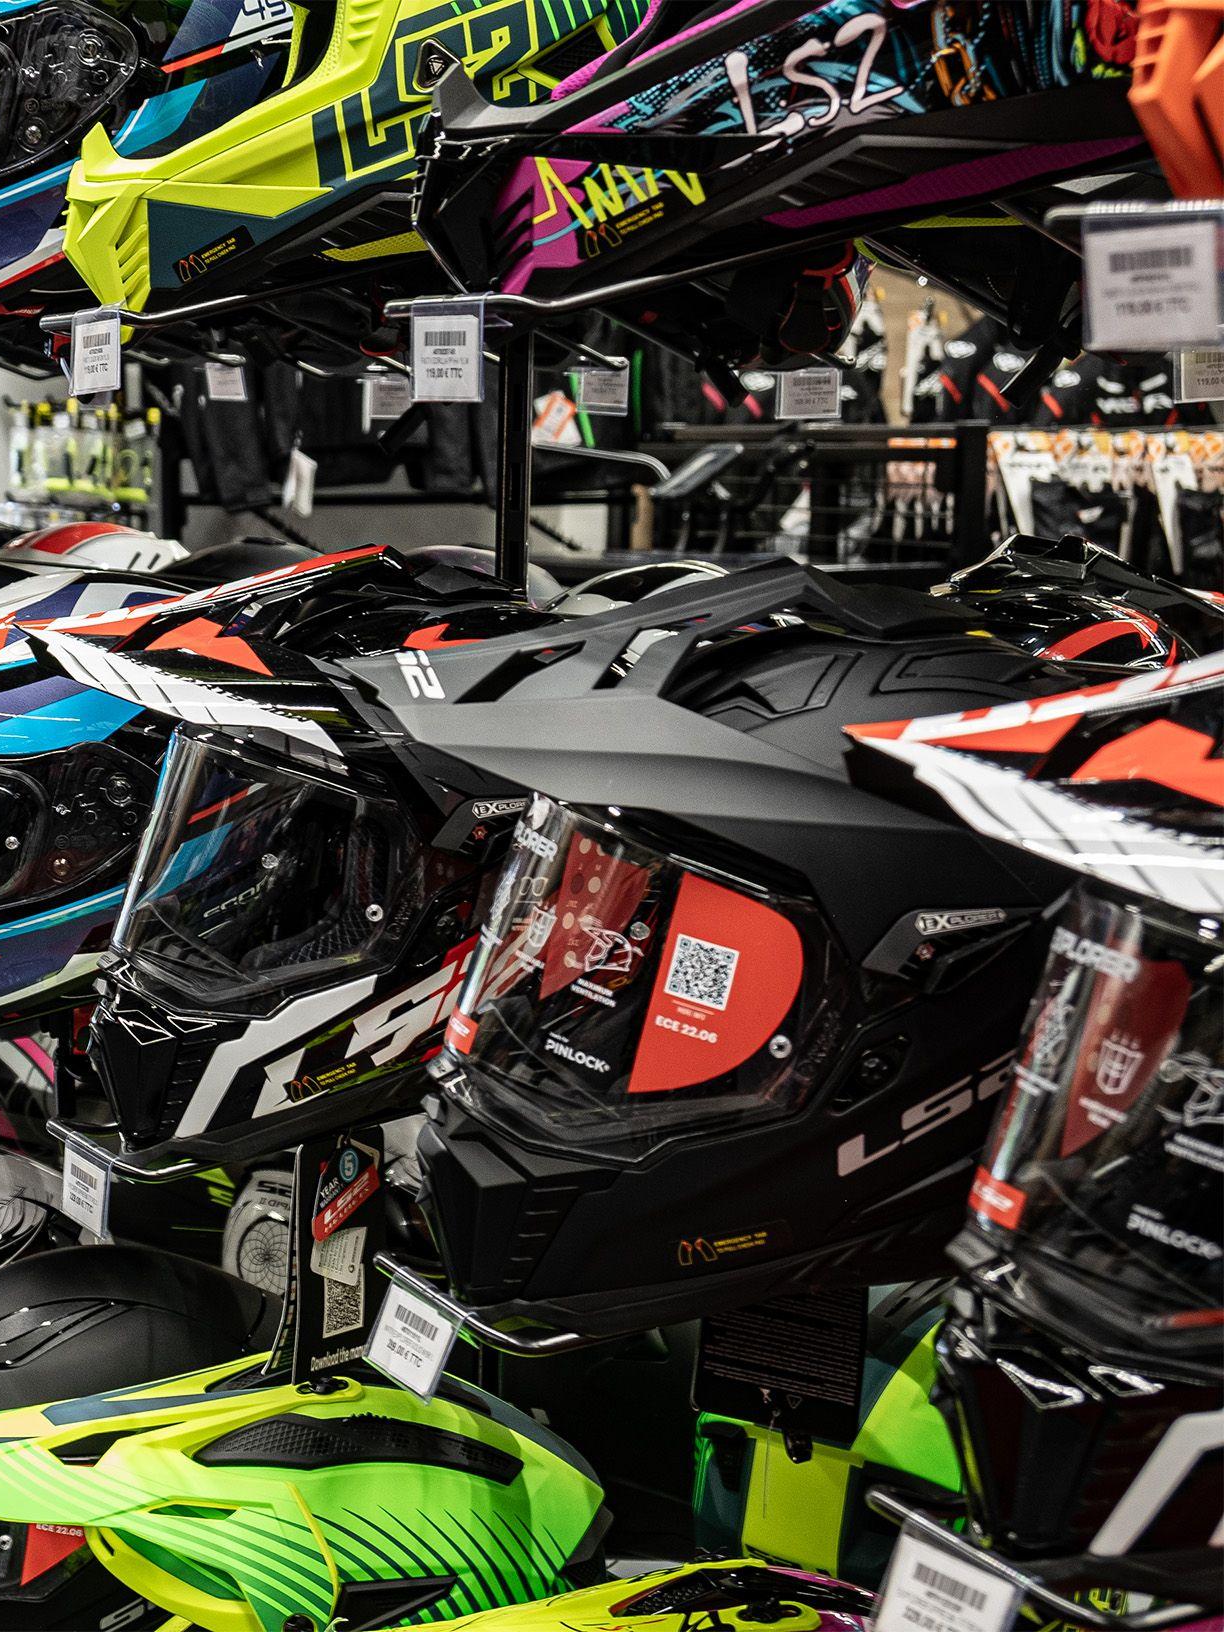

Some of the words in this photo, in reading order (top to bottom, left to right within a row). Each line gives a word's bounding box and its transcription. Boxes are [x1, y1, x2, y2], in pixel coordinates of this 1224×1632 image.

[450, 367, 463, 379] TTC
[478, 800, 526, 815] EXPLOR
[514, 820, 558, 862] PLORER
[655, 1014, 681, 1033] ECE
[680, 1023, 719, 1044] 22.06
[320, 1177, 339, 1199] YEAR
[324, 1172, 370, 1225] LS2
